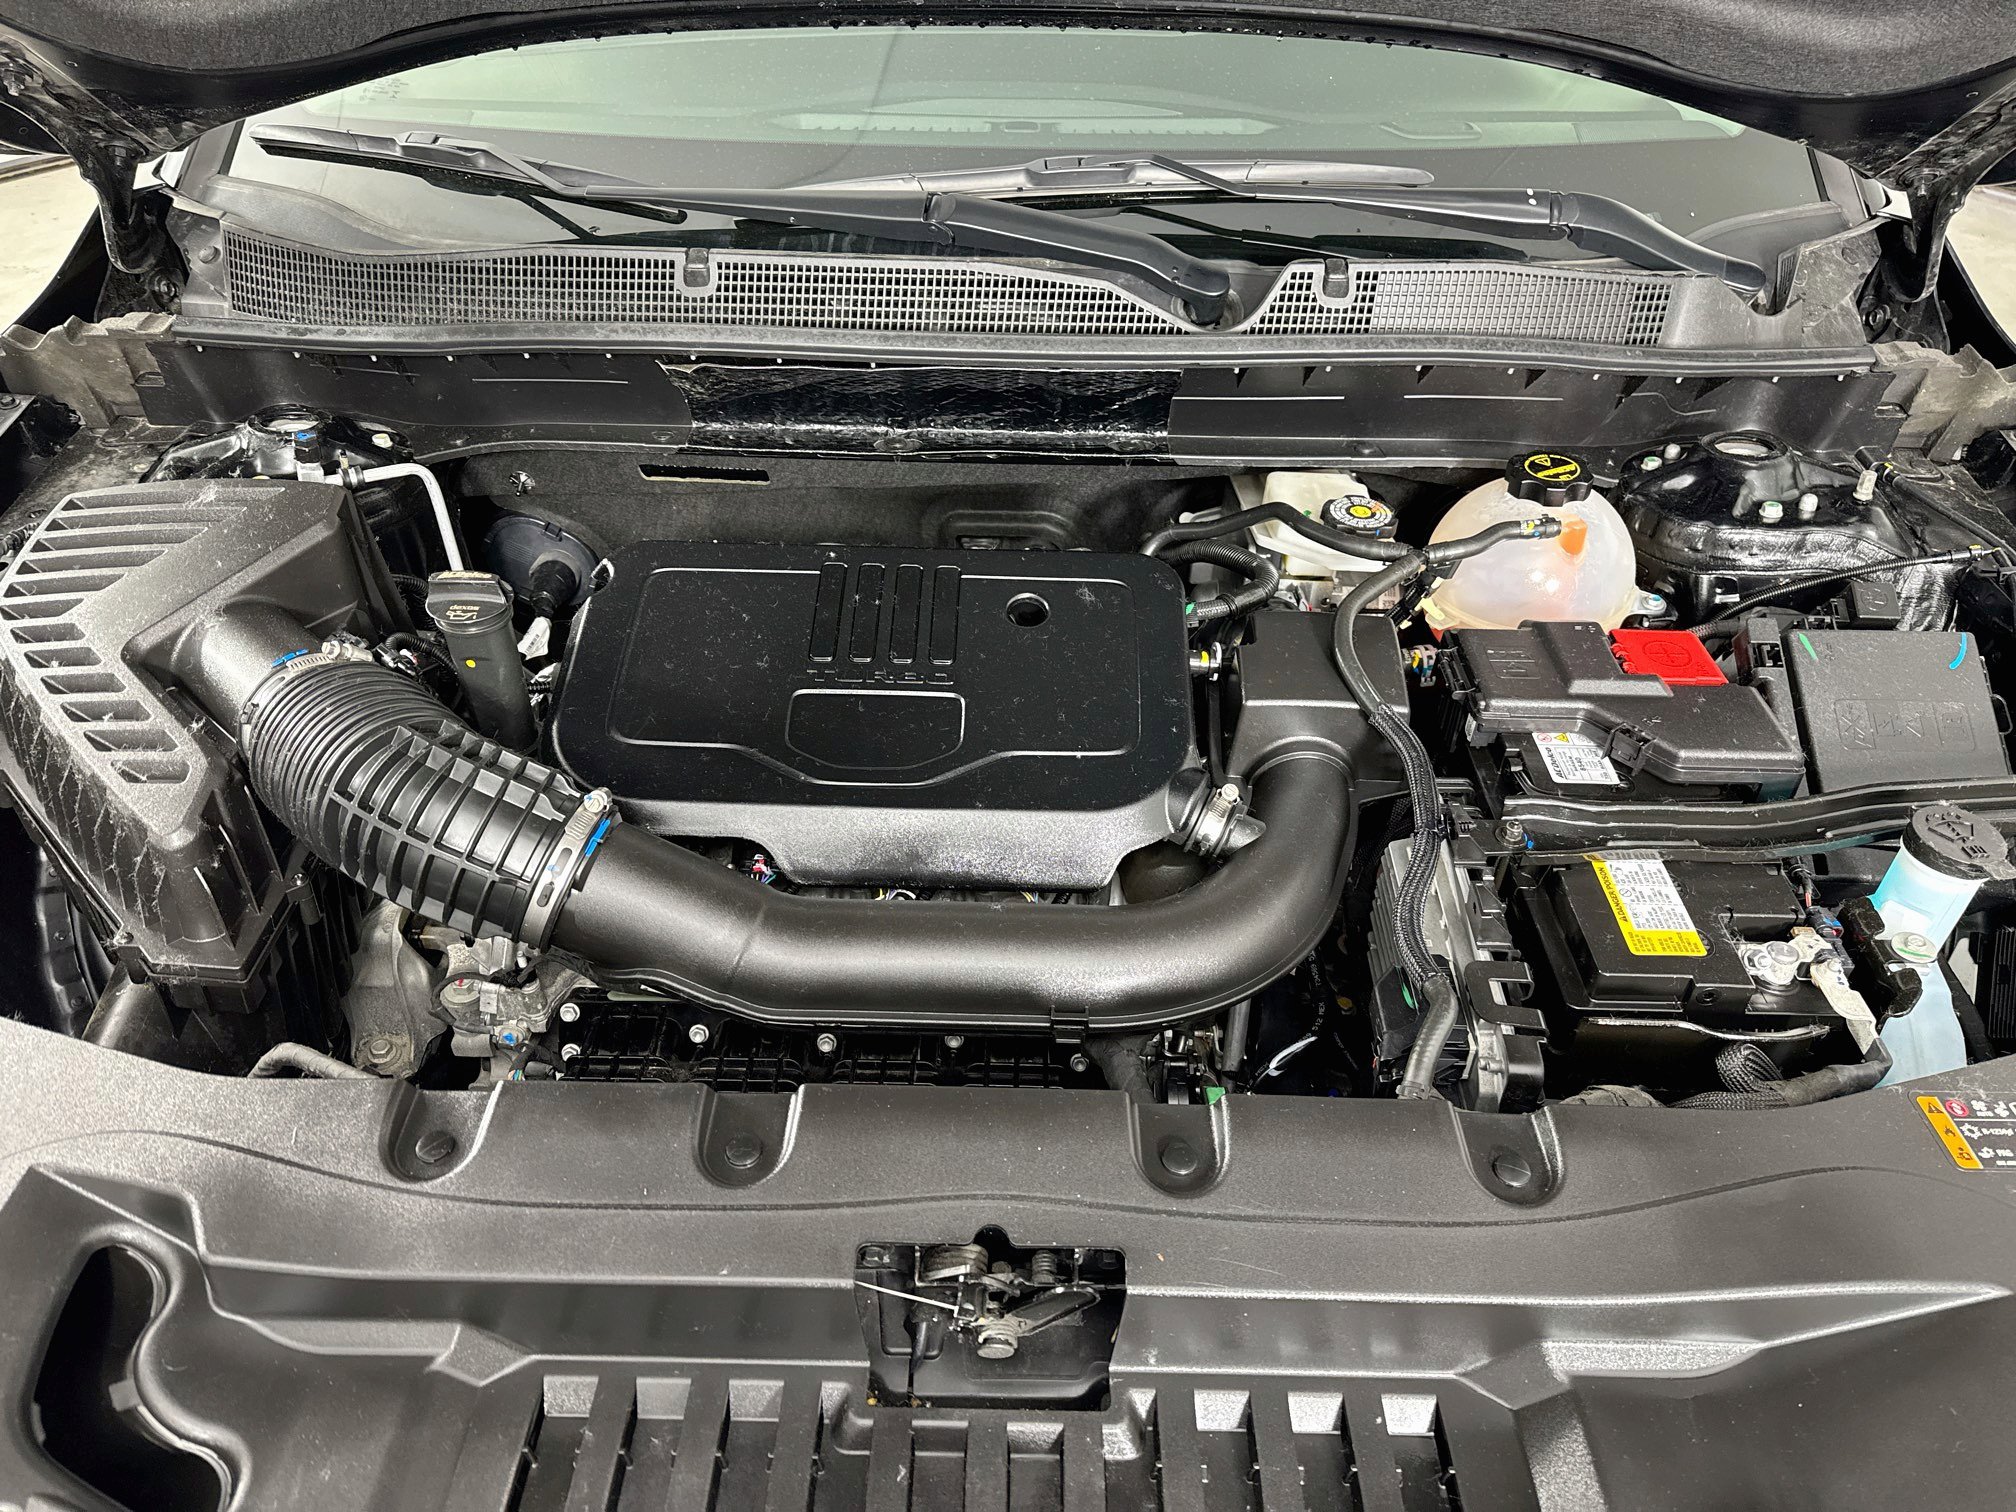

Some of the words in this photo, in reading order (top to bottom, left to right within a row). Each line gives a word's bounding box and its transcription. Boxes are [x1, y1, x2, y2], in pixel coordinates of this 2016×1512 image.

[805, 669, 954, 685] TURBO
[1545, 747, 1564, 778] ACDelco
[1599, 867, 1614, 891] POISON
[1608, 890, 1626, 916] DANGER
